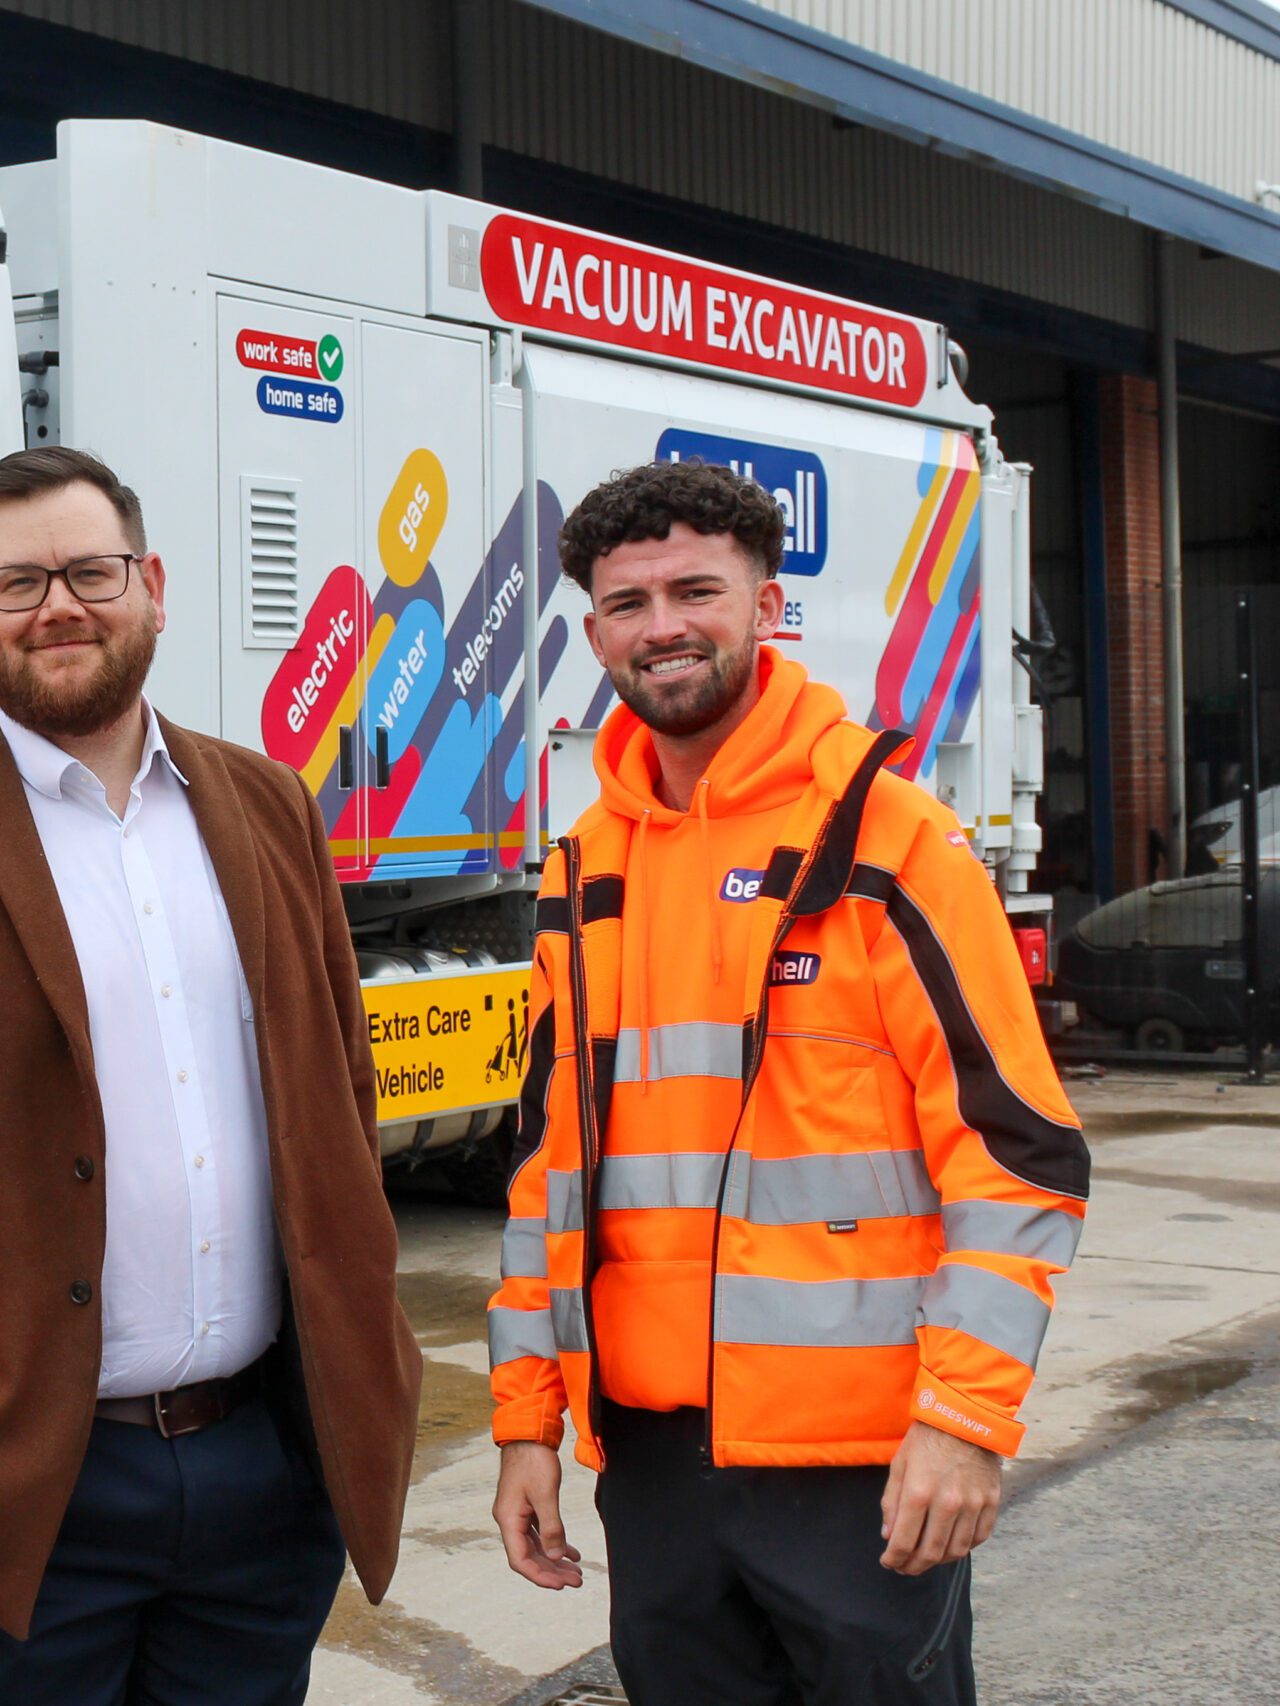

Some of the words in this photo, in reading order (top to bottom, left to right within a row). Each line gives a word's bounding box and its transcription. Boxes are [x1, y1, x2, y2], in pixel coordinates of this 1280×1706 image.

[511, 236, 693, 342] VACUUM
[706, 286, 907, 389] EXCAVATOR
[243, 341, 279, 363] work
[282, 346, 312, 368] safe
[266, 383, 304, 409] home
[308, 392, 337, 414] safe
[398, 482, 430, 552] gas
[452, 562, 524, 696] telecoms
[287, 608, 355, 733] electric
[378, 629, 428, 729] water
[368, 1012, 420, 1044] Extra
[427, 1006, 471, 1036] Care
[376, 1062, 444, 1099] Vehicle
[934, 1402, 992, 1437] BEESWIFT
